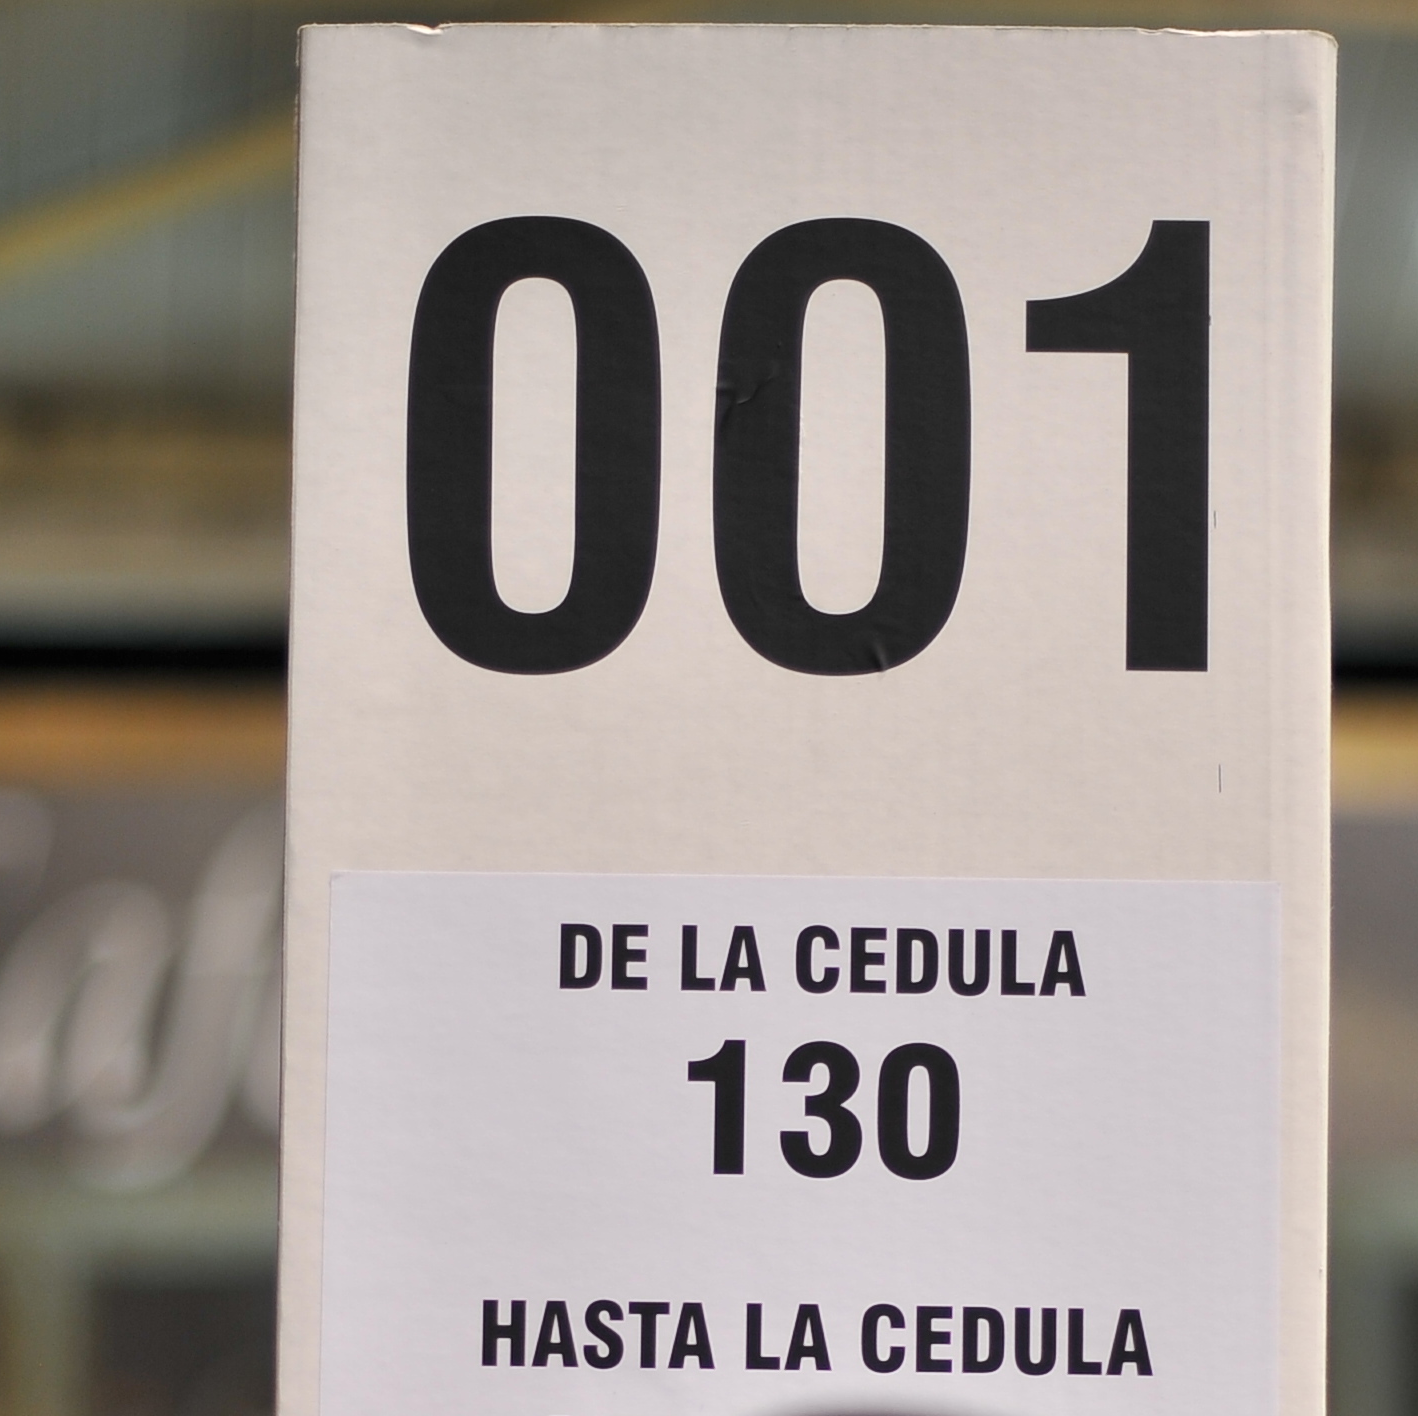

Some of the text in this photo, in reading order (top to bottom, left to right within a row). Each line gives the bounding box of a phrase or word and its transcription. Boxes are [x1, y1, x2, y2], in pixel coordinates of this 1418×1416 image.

[406, 215, 1211, 677] 001
[559, 923, 1086, 997] DE LA CEDULA
[687, 1039, 961, 1181] 130
[481, 1299, 1153, 1377] HASTA LA CEDULA
